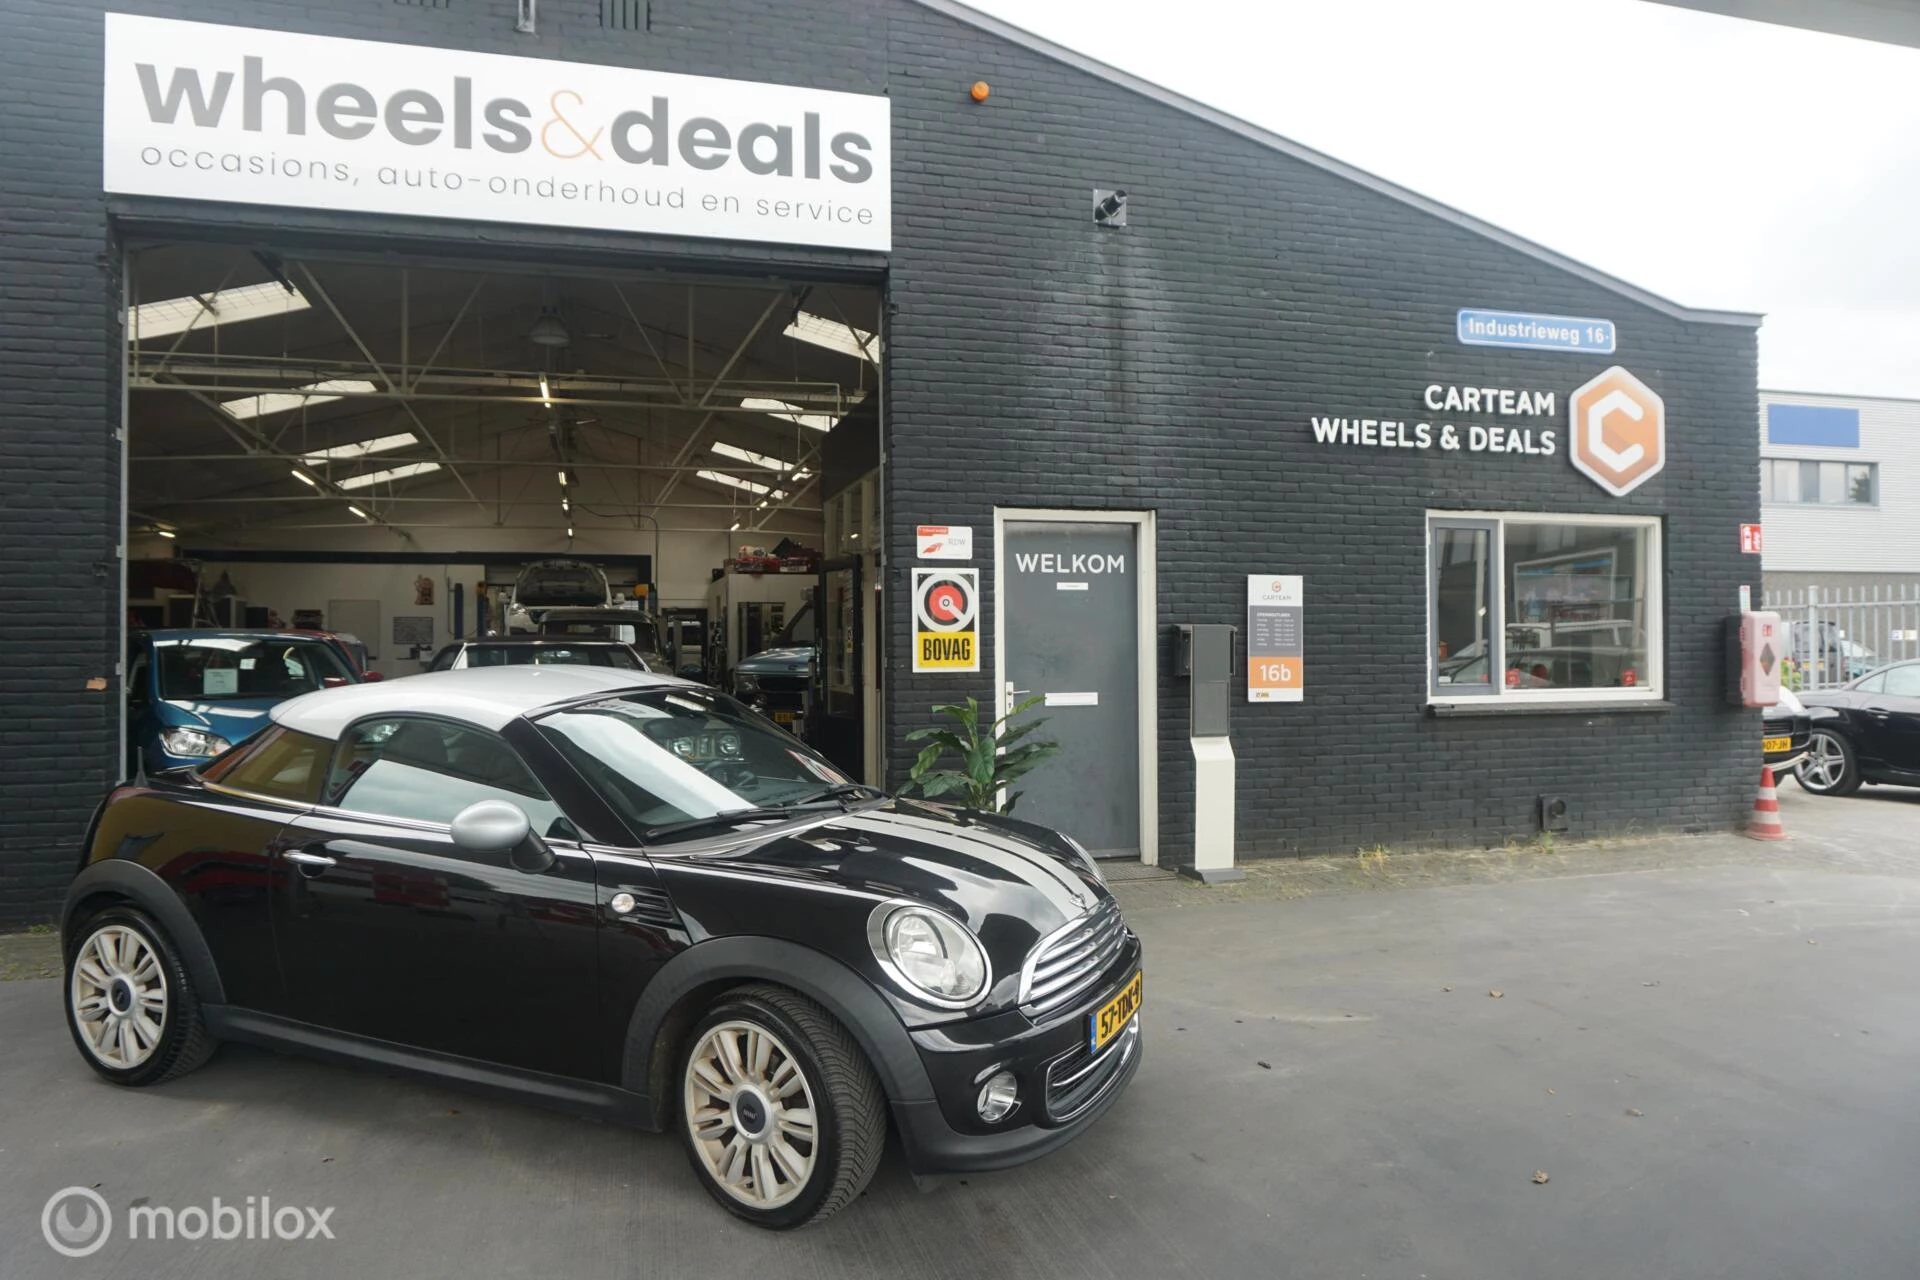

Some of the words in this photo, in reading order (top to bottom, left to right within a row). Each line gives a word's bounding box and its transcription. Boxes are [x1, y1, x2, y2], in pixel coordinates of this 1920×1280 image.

[140, 146, 359, 186] occasions,
[377, 165, 684, 209] auto-onderhoud
[701, 194, 739, 213] en
[756, 198, 873, 225] service
[1468, 317, 1581, 344] Industrieweg
[1586, 326, 1605, 343] 16
[1424, 384, 1555, 416] CARTEAM
[1311, 416, 1432, 449] WHEELS
[1439, 425, 1460, 451] &
[1469, 427, 1556, 456] DEALS
[1015, 553, 1125, 574] WELKOM
[922, 637, 971, 661] BOVAG
[1259, 663, 1292, 682] 16b
